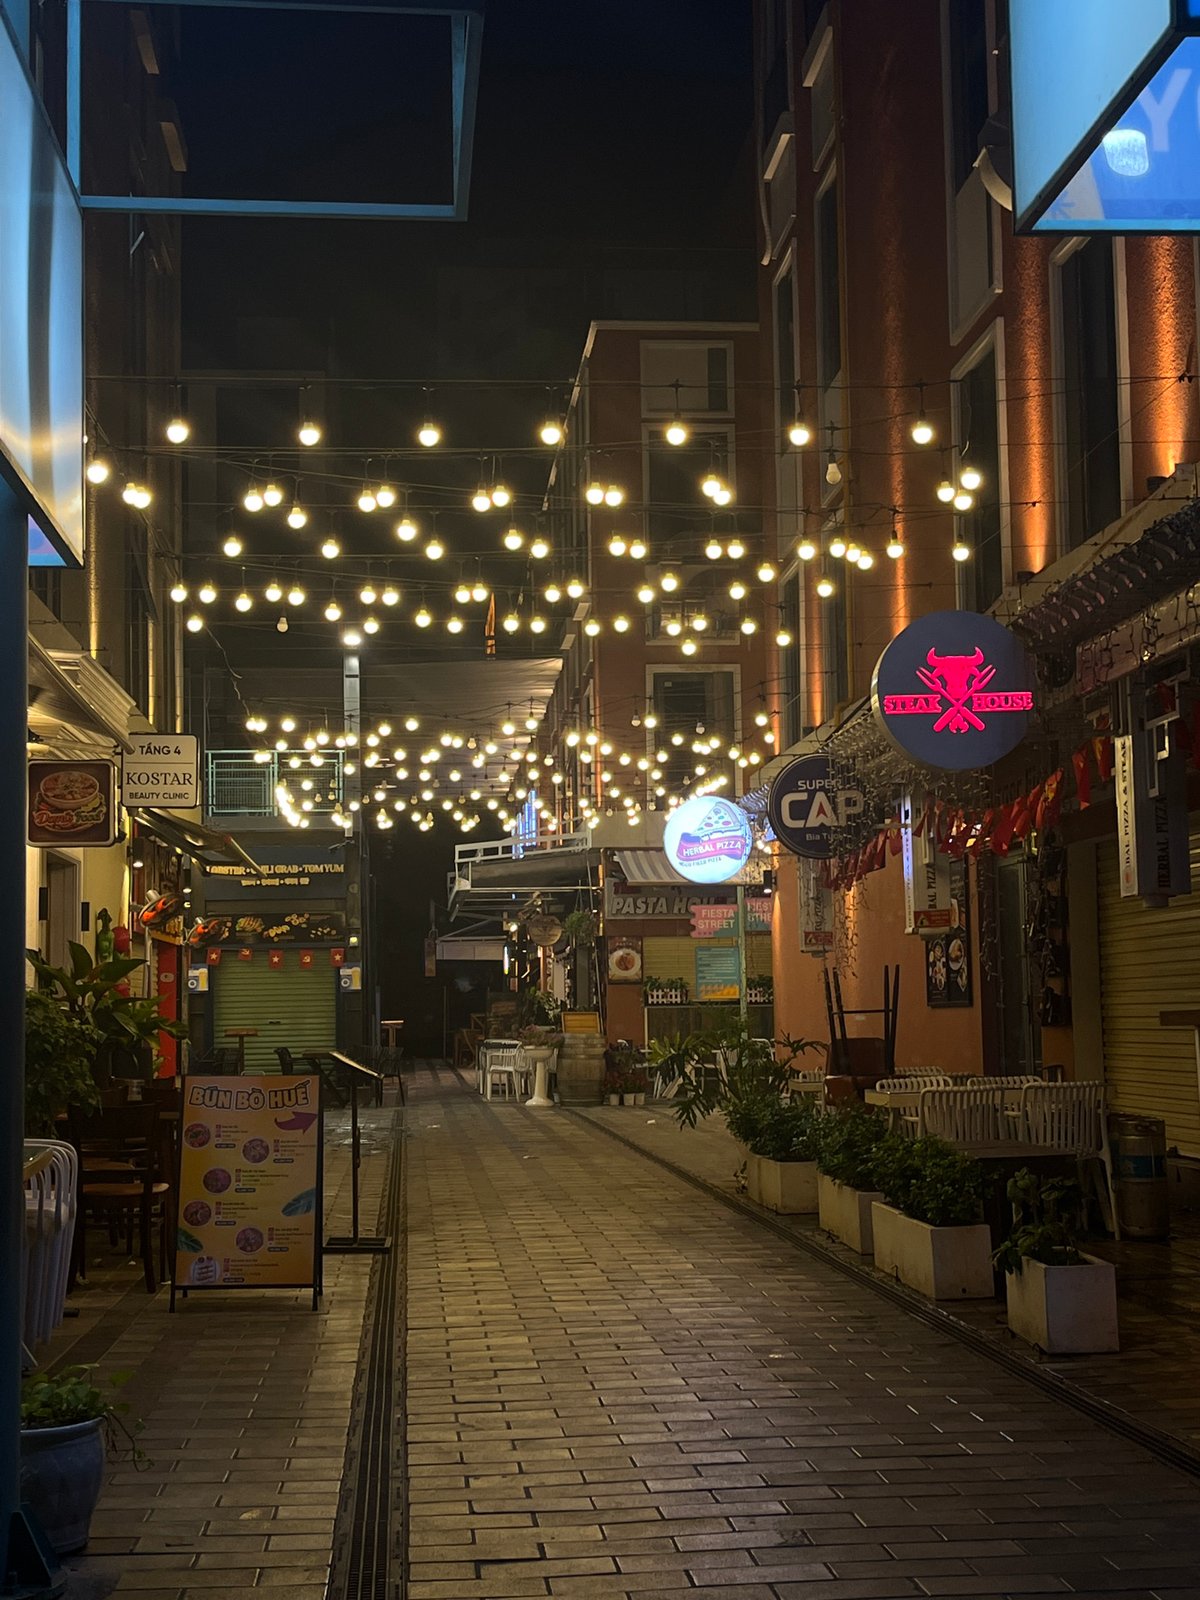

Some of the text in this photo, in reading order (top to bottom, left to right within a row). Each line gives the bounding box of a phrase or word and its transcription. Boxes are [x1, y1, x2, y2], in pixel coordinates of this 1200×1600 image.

[883, 695, 1033, 711] STEAK HOUSE
[173, 746, 182, 755] 4
[1120, 740, 1128, 783] STEAK
[126, 772, 193, 786] KOSTAR
[797, 778, 842, 791] SUPER
[781, 790, 864, 828] CAP
[805, 833, 821, 841] Bia
[1155, 795, 1170, 888] HERBAL PIZZA
[683, 841, 741, 856] HERBAL PIZZA
[302, 864, 324, 873] TOM
[323, 864, 344, 873] YUM
[611, 897, 668, 914] PASTA
[701, 909, 735, 918] FIESTA
[697, 919, 735, 929] STREET
[189, 1080, 311, 1110] BÚN BÒ HUẾ
